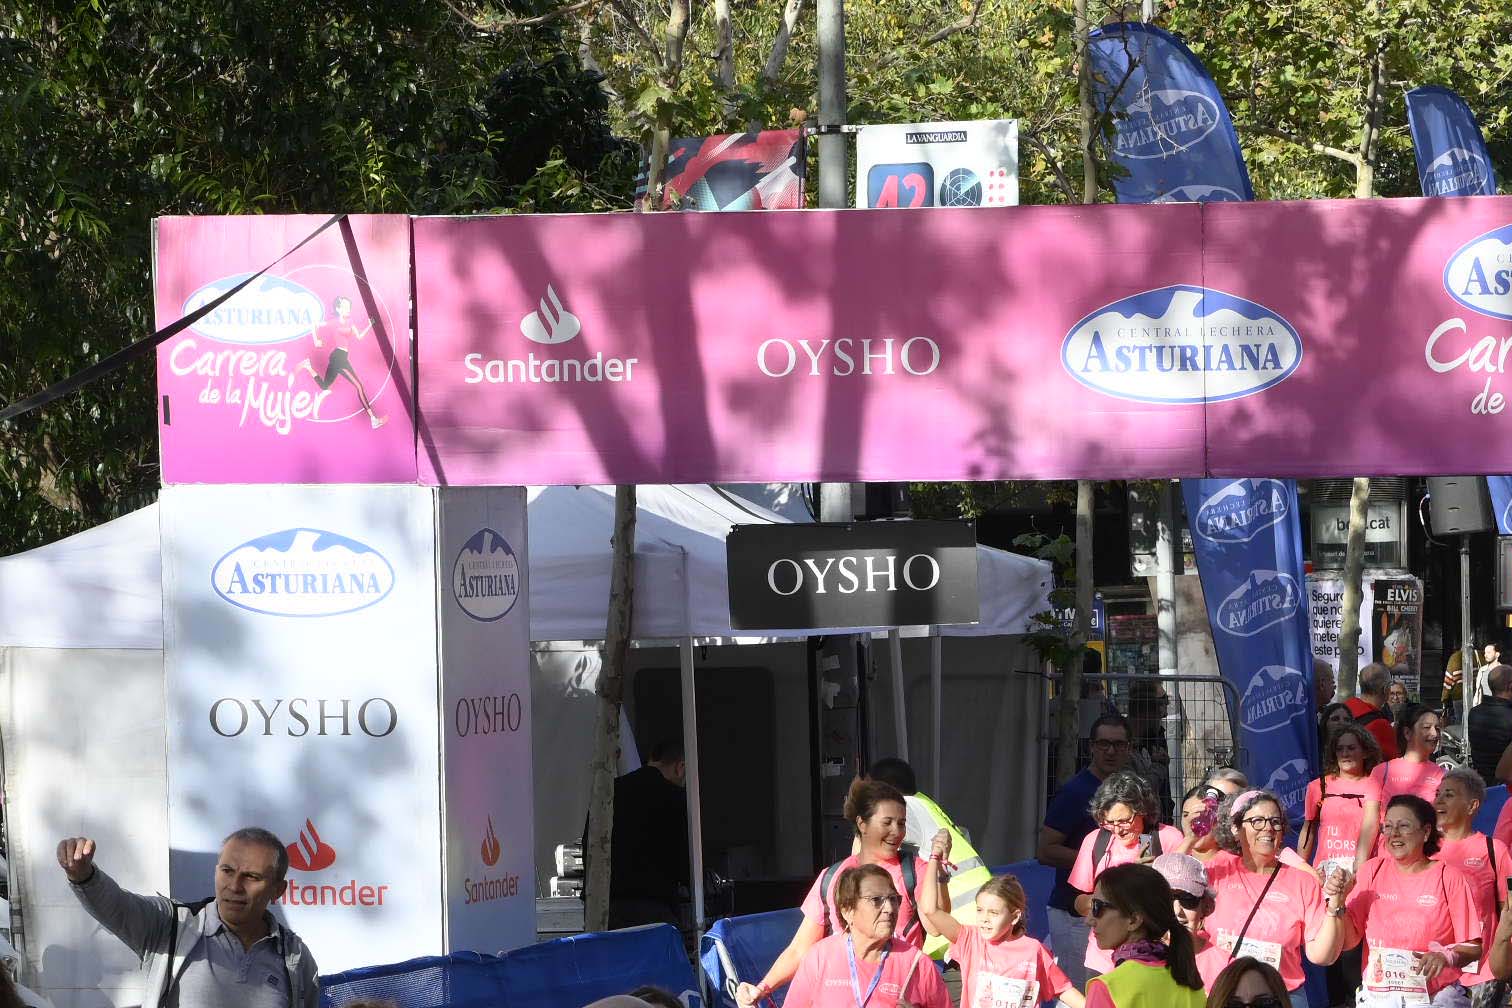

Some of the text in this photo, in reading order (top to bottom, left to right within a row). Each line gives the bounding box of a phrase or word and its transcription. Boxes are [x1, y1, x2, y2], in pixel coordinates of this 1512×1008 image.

[1080, 330, 1285, 374] ASTURIANA
[1115, 326, 1190, 341] CENTRAL
[169, 338, 288, 379] Carrera
[463, 350, 639, 385] Santander
[756, 336, 941, 378] OYSHO
[199, 374, 332, 436] de la Mujer
[1470, 377, 1505, 416] de
[226, 560, 382, 596] ASTURIANA
[457, 563, 517, 599] ASTURIANA
[767, 553, 941, 596] OYSHO
[1312, 605, 1328, 618] que
[1387, 588, 1418, 602] ELVIS
[1314, 643, 1333, 656] este
[208, 697, 399, 738] OYSHO
[455, 693, 522, 739] OYSHO
[464, 871, 521, 906] Santander
